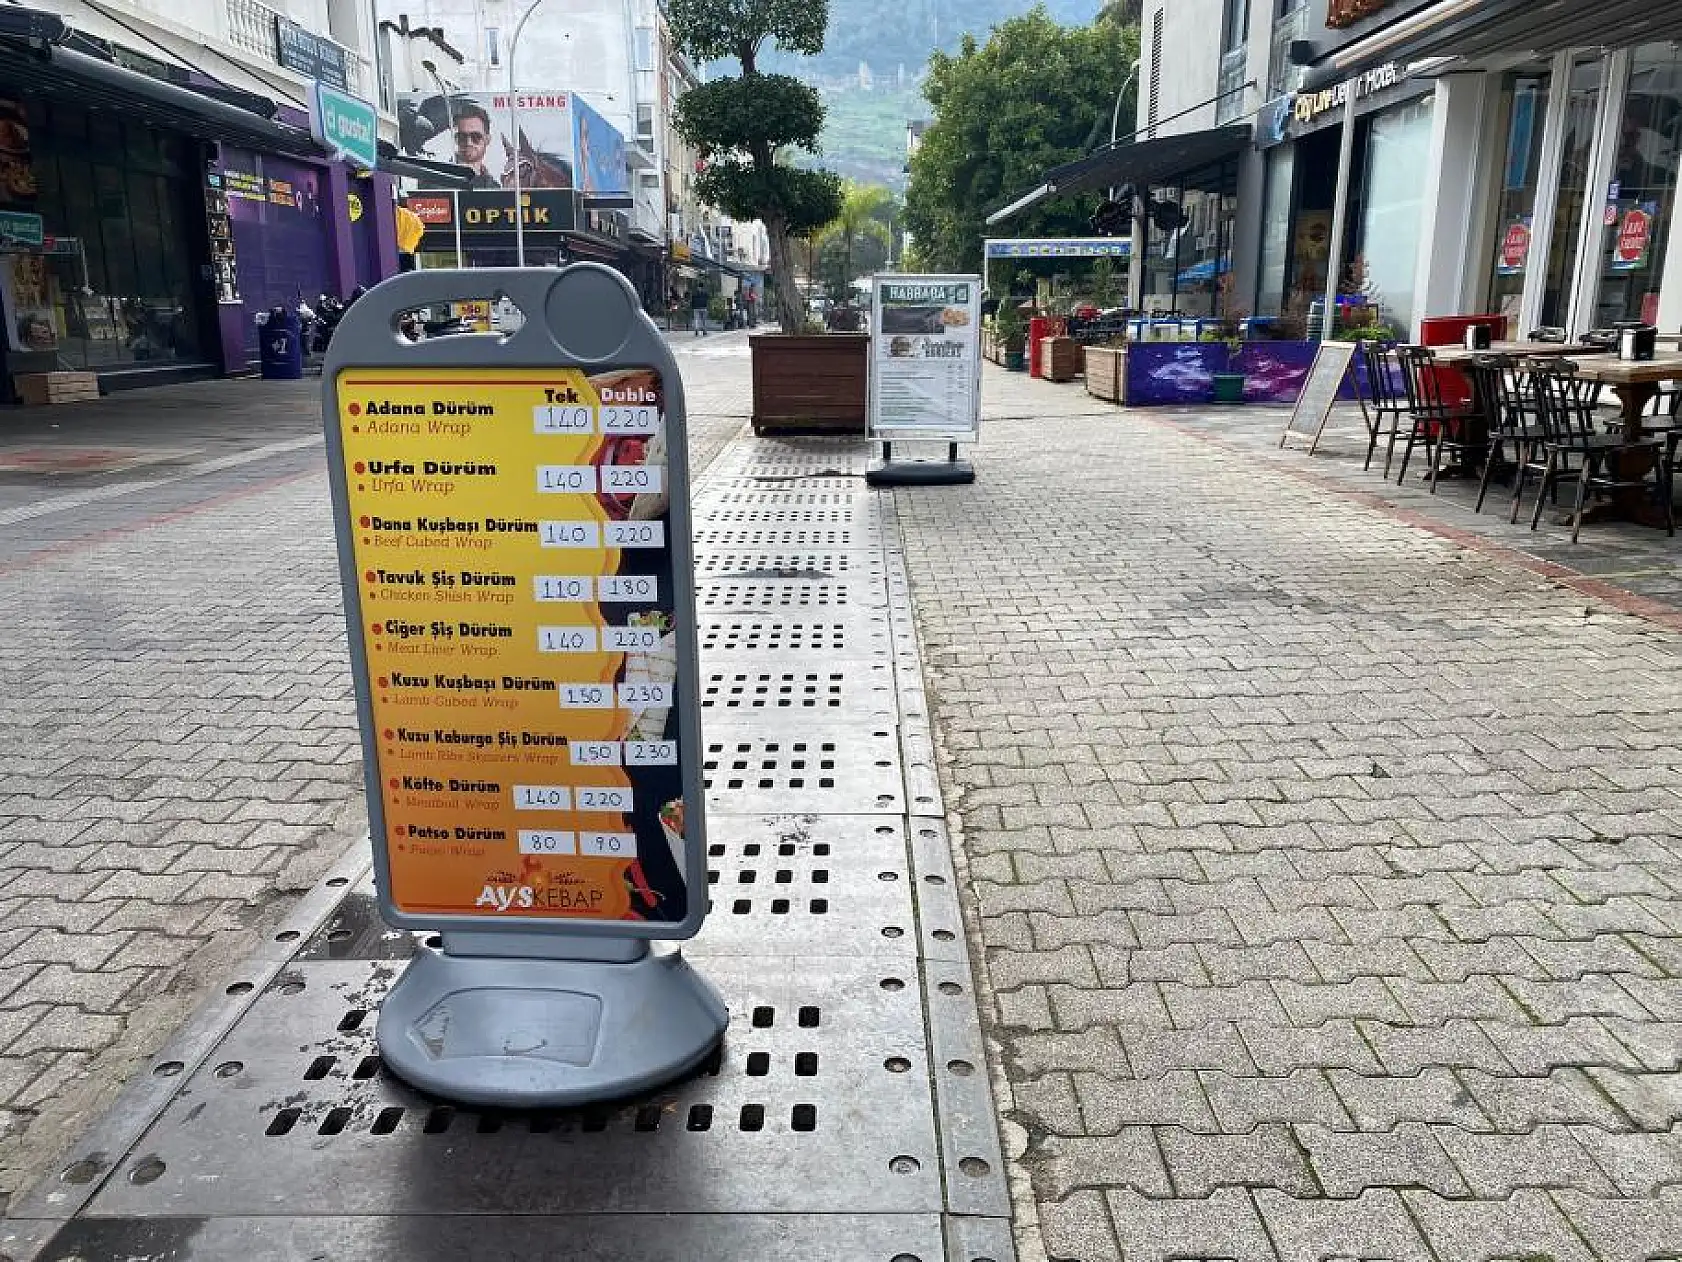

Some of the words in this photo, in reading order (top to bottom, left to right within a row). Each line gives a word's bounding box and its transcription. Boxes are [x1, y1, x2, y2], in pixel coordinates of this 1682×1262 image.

[545, 388, 578, 403] Tek
[602, 387, 655, 401] Duble
[366, 401, 425, 415] Adana
[432, 401, 494, 415] Dürüm
[545, 406, 587, 431] 140
[607, 409, 648, 427] 220
[368, 421, 420, 433] Adana
[428, 421, 471, 436] Wrap
[368, 460, 414, 474] Urfa
[424, 461, 496, 475] Dürüm
[545, 470, 582, 489] 140
[610, 470, 648, 486] 220
[372, 478, 404, 494] Urfa
[412, 479, 454, 495] Wrap
[372, 517, 411, 530] Dana
[417, 517, 479, 535] Kuşbaşı
[486, 518, 538, 532] Dürüm
[545, 524, 585, 543] 140
[375, 535, 404, 547] Beef
[455, 536, 492, 550] Wrap
[616, 526, 652, 543] 220
[376, 569, 425, 584] Tavuk
[432, 570, 455, 588] Şiş
[461, 571, 516, 586] Dürüm
[609, 579, 650, 594] 180
[380, 588, 432, 601] Chicken
[477, 591, 514, 604] Wrap
[541, 580, 580, 598] 110
[386, 620, 425, 638] Ciğer
[430, 622, 453, 640] Şiş
[459, 622, 512, 637] Dürüm
[546, 632, 583, 650] 140
[615, 632, 654, 646] 220
[391, 672, 429, 687] Kuzu
[434, 673, 496, 693] Kuşbaşı
[502, 676, 556, 690] Dürüm
[567, 687, 602, 703] 150
[626, 686, 663, 701] 230
[397, 728, 430, 743] Kuzu
[434, 729, 493, 747] Kaburga
[499, 730, 518, 748] Şiş
[522, 730, 568, 746] Dürüm
[578, 746, 612, 762] 150
[634, 744, 671, 759] 230
[402, 776, 444, 792] Köfte
[449, 778, 500, 793] Dürüm
[526, 788, 560, 804] 140
[585, 792, 622, 806] 220
[408, 825, 449, 839] Patso
[454, 826, 505, 840] Dürüm
[532, 835, 556, 850] 80
[596, 836, 621, 851] 90
